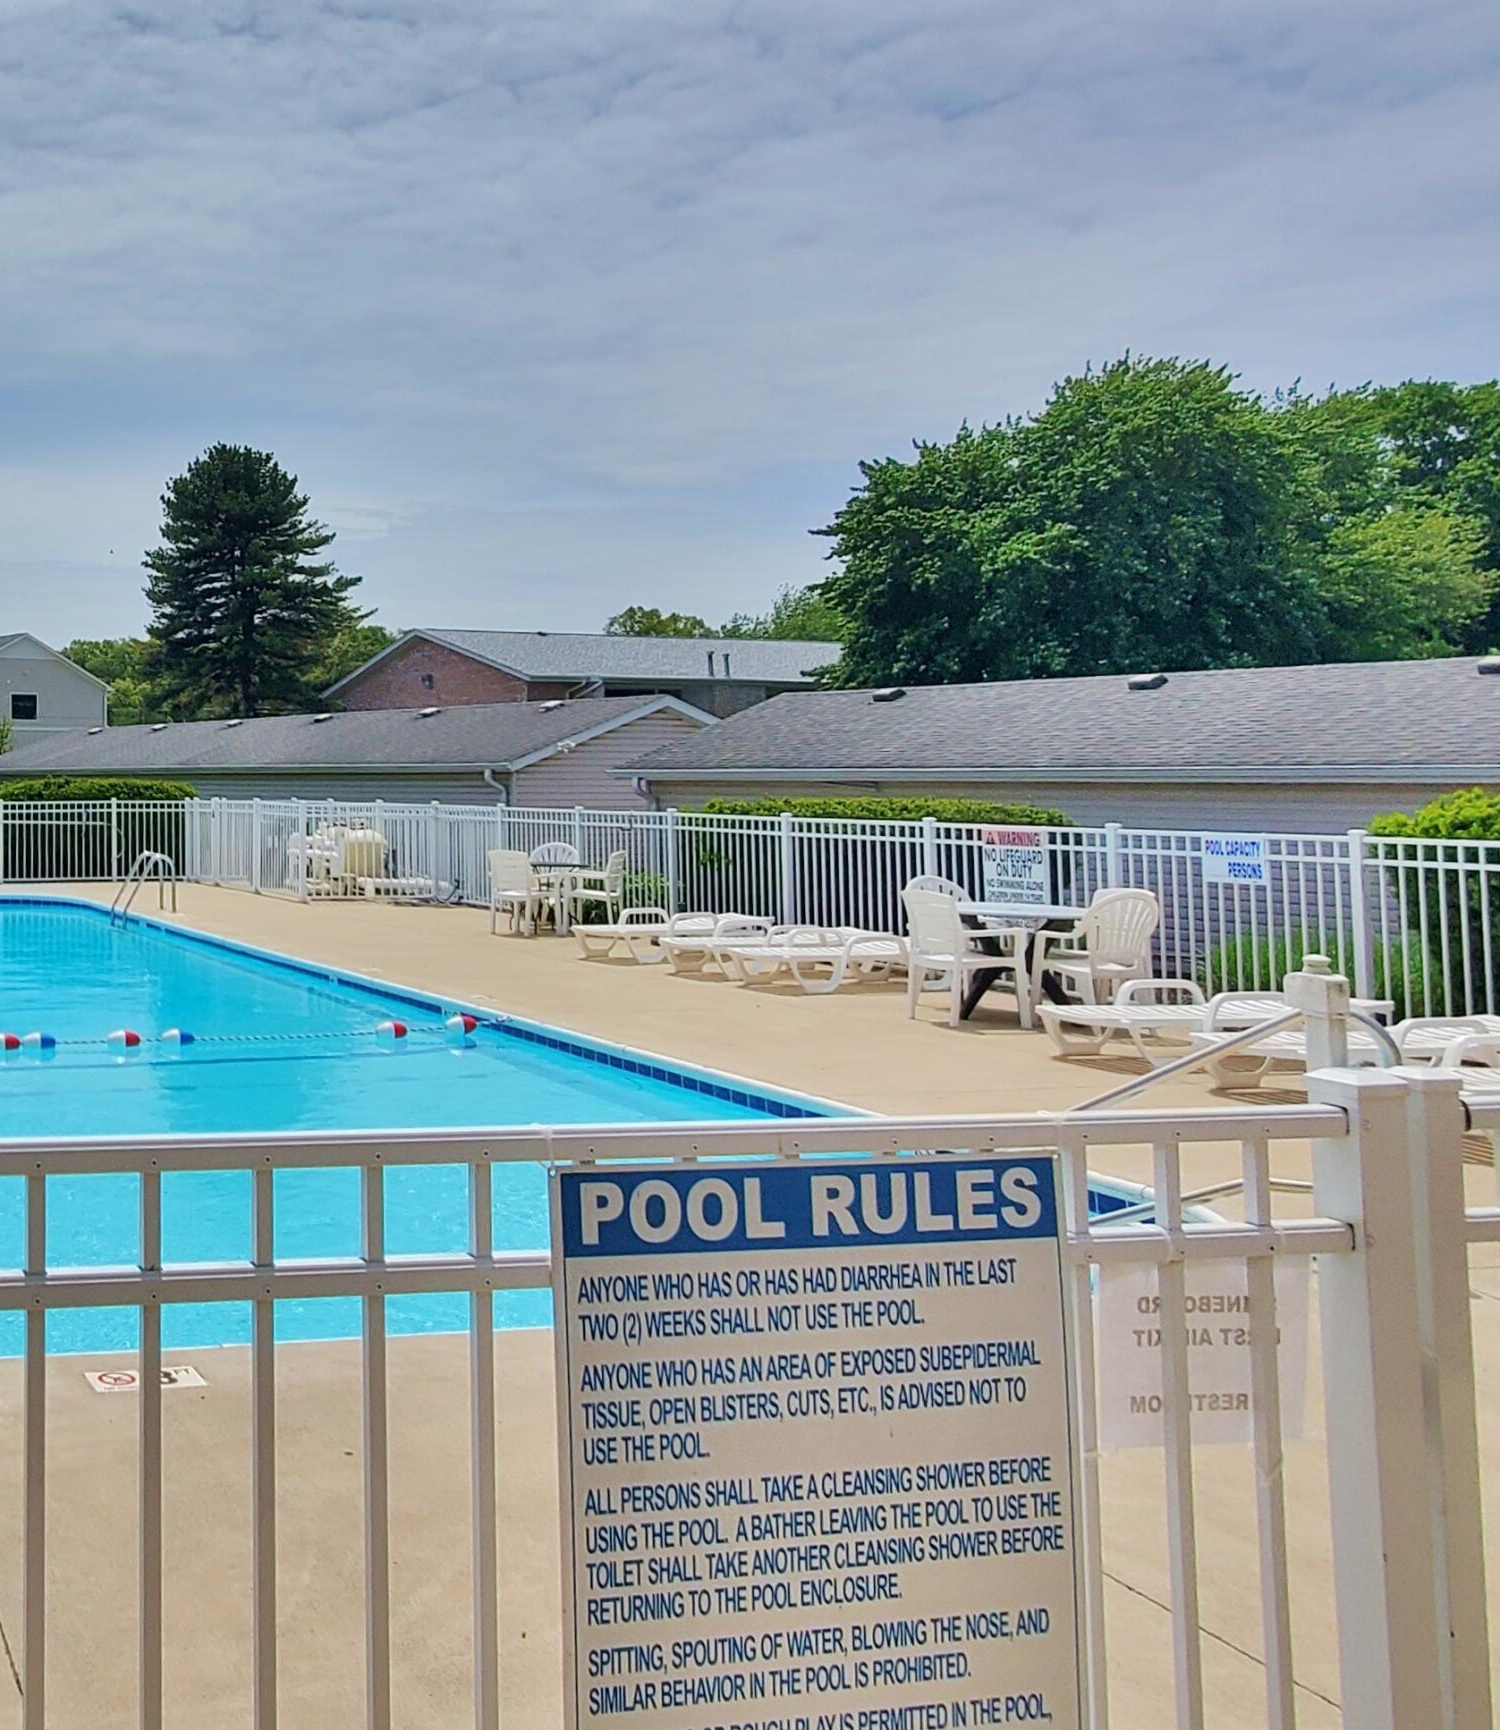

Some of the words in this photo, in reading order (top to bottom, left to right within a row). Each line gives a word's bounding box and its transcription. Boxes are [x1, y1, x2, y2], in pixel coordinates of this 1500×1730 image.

[984, 848, 997, 862] NO
[1000, 848, 1043, 864] LIFEGUARD
[998, 832, 1041, 847] WARNING
[1205, 840, 1224, 855] POOL
[1226, 841, 1260, 857] CAPACITY
[996, 862, 1009, 877] ON
[1011, 863, 1033, 879] DUTY
[1228, 862, 1262, 879] PERSONS
[579, 1177, 785, 1246] POOL
[810, 1167, 1042, 1237] RULES
[577, 1274, 650, 1305] ANYONE
[651, 1272, 695, 1301] WHO
[697, 1271, 733, 1299] HAS
[735, 1270, 762, 1298] OR
[764, 1268, 800, 1296] HAS
[802, 1266, 838, 1295] HAD
[840, 1262, 924, 1293] DIARRHEA
[924, 1261, 941, 1288] IN
[942, 1260, 976, 1287] THE
[977, 1258, 1017, 1285] LAST
[577, 1312, 619, 1342] TWO
[622, 1311, 643, 1347] (2)
[644, 1308, 707, 1339] WEEKS
[709, 1306, 765, 1336] SHALL
[767, 1304, 802, 1333] NOT
[804, 1302, 839, 1331] USE
[840, 1300, 874, 1329] THE
[876, 1298, 925, 1327] POOL.
[580, 1361, 653, 1393] ANYONE
[654, 1359, 698, 1389] WHO
[700, 1357, 737, 1386] HAS
[738, 1355, 763, 1384] AN
[765, 1353, 813, 1382] AREA
[814, 1351, 837, 1379] OF
[840, 1347, 917, 1377] EXPOSED
[919, 1340, 1042, 1373] SUBEPIDERMAL
[580, 1399, 646, 1431] TISSUE,
[649, 1396, 697, 1426] OPEN
[699, 1391, 784, 1423] BLISTERS,
[786, 1388, 835, 1419] CUTS,
[837, 1385, 877, 1416] ETC.,
[879, 1384, 895, 1411] IS
[897, 1380, 966, 1410] ADVISED
[968, 1377, 1002, 1406] NOT
[1003, 1375, 1027, 1403] TO
[582, 1436, 619, 1466] USE
[620, 1434, 656, 1464] THE
[659, 1431, 711, 1461] POOL.
[584, 1487, 618, 1517] ALL
[620, 1481, 702, 1515] PERSONS
[704, 1478, 760, 1509] SHALL
[760, 1474, 805, 1504] TAKE
[806, 1473, 820, 1501] A
[821, 1466, 913, 1500] CLEANSING
[915, 1461, 987, 1492] SHOWER
[988, 1456, 1052, 1487] BEFORE
[585, 1523, 638, 1555] USING
[640, 1520, 676, 1551] THE
[678, 1517, 729, 1548] POOL.
[735, 1515, 749, 1543] A
[750, 1510, 817, 1542] BATHER
[819, 1504, 888, 1536] LEAVING
[889, 1501, 923, 1530] THE
[924, 1498, 970, 1528] POOL
[970, 1496, 994, 1524] TO
[995, 1493, 1029, 1522] USE
[1029, 1490, 1063, 1519] THE
[585, 1558, 645, 1591] TOILET
[647, 1554, 703, 1586] SHALL
[704, 1550, 749, 1580] TAKE
[751, 1543, 832, 1577] ANOTHER
[833, 1535, 926, 1570] CLEANSING
[928, 1530, 999, 1561] SHOWER
[1000, 1524, 1065, 1555] BEFORE
[587, 1590, 685, 1627] RETURNING
[687, 1588, 712, 1617] TO
[713, 1585, 748, 1615] THE
[751, 1581, 798, 1612] POOL
[800, 1572, 903, 1607] ENCLOSURE.
[588, 1643, 668, 1678] SPITTING,
[671, 1634, 757, 1670] SPOUTING
[760, 1632, 784, 1661] OF
[786, 1626, 848, 1658] WATER,
[851, 1618, 928, 1652] BLOWING
[929, 1615, 963, 1644] THE
[965, 1611, 1014, 1641] NOSE,
[1015, 1607, 1050, 1637] AND
[588, 1682, 658, 1716] SIMILAR
[660, 1673, 747, 1709] BEHAVIOR
[749, 1671, 766, 1700] IN
[768, 1668, 802, 1697] THE
[805, 1663, 852, 1694] POOL
[854, 1661, 870, 1689] IS
[872, 1651, 972, 1687] PROHIBITED.
[839, 1712, 855, 1730] IS
[857, 1703, 948, 1730] PERMITTED
[951, 1700, 967, 1728] IN
[969, 1697, 1002, 1726] THE
[1004, 1692, 1053, 1723] POOL,
